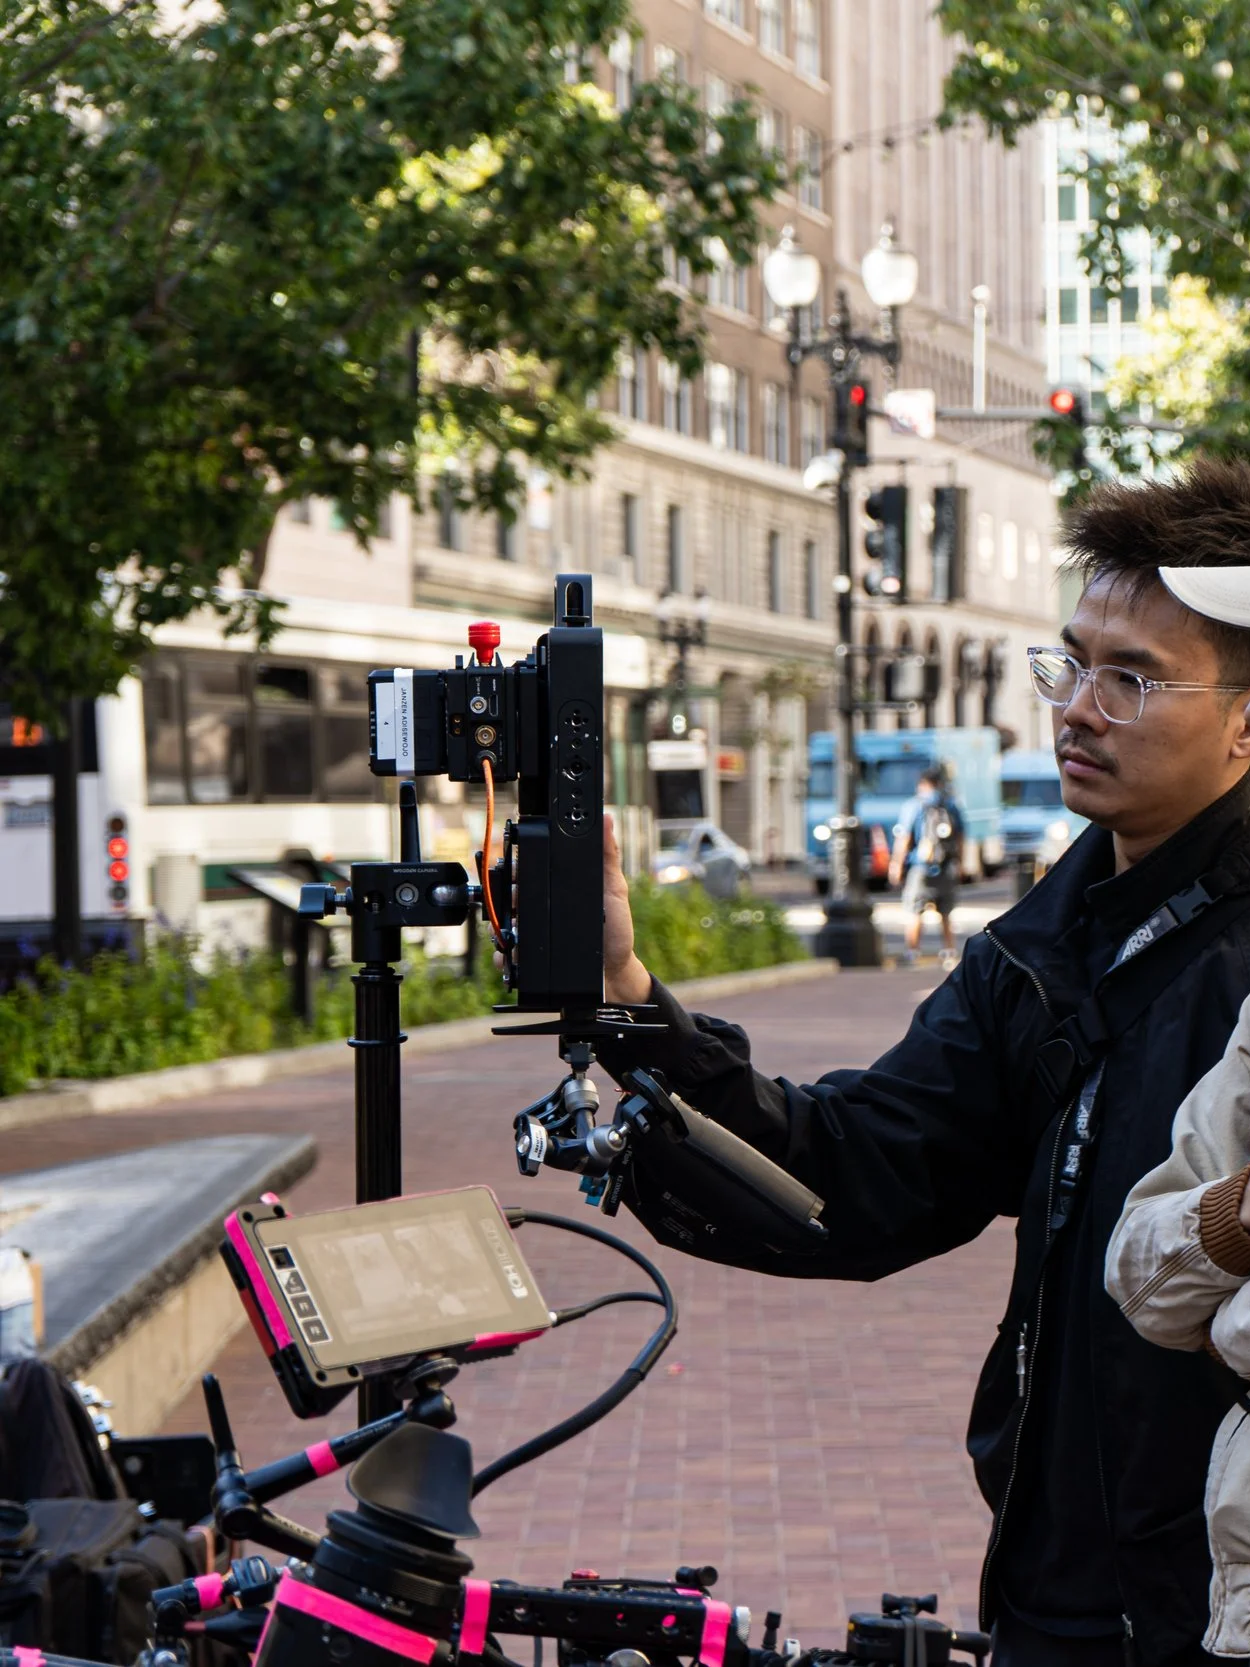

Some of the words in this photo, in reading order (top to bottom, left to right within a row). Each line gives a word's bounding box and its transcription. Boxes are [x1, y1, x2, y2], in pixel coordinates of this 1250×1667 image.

[400, 687, 408, 714] JANZEN
[401, 715, 409, 757] ADISEWOJO
[1121, 924, 1154, 961] ARRI
